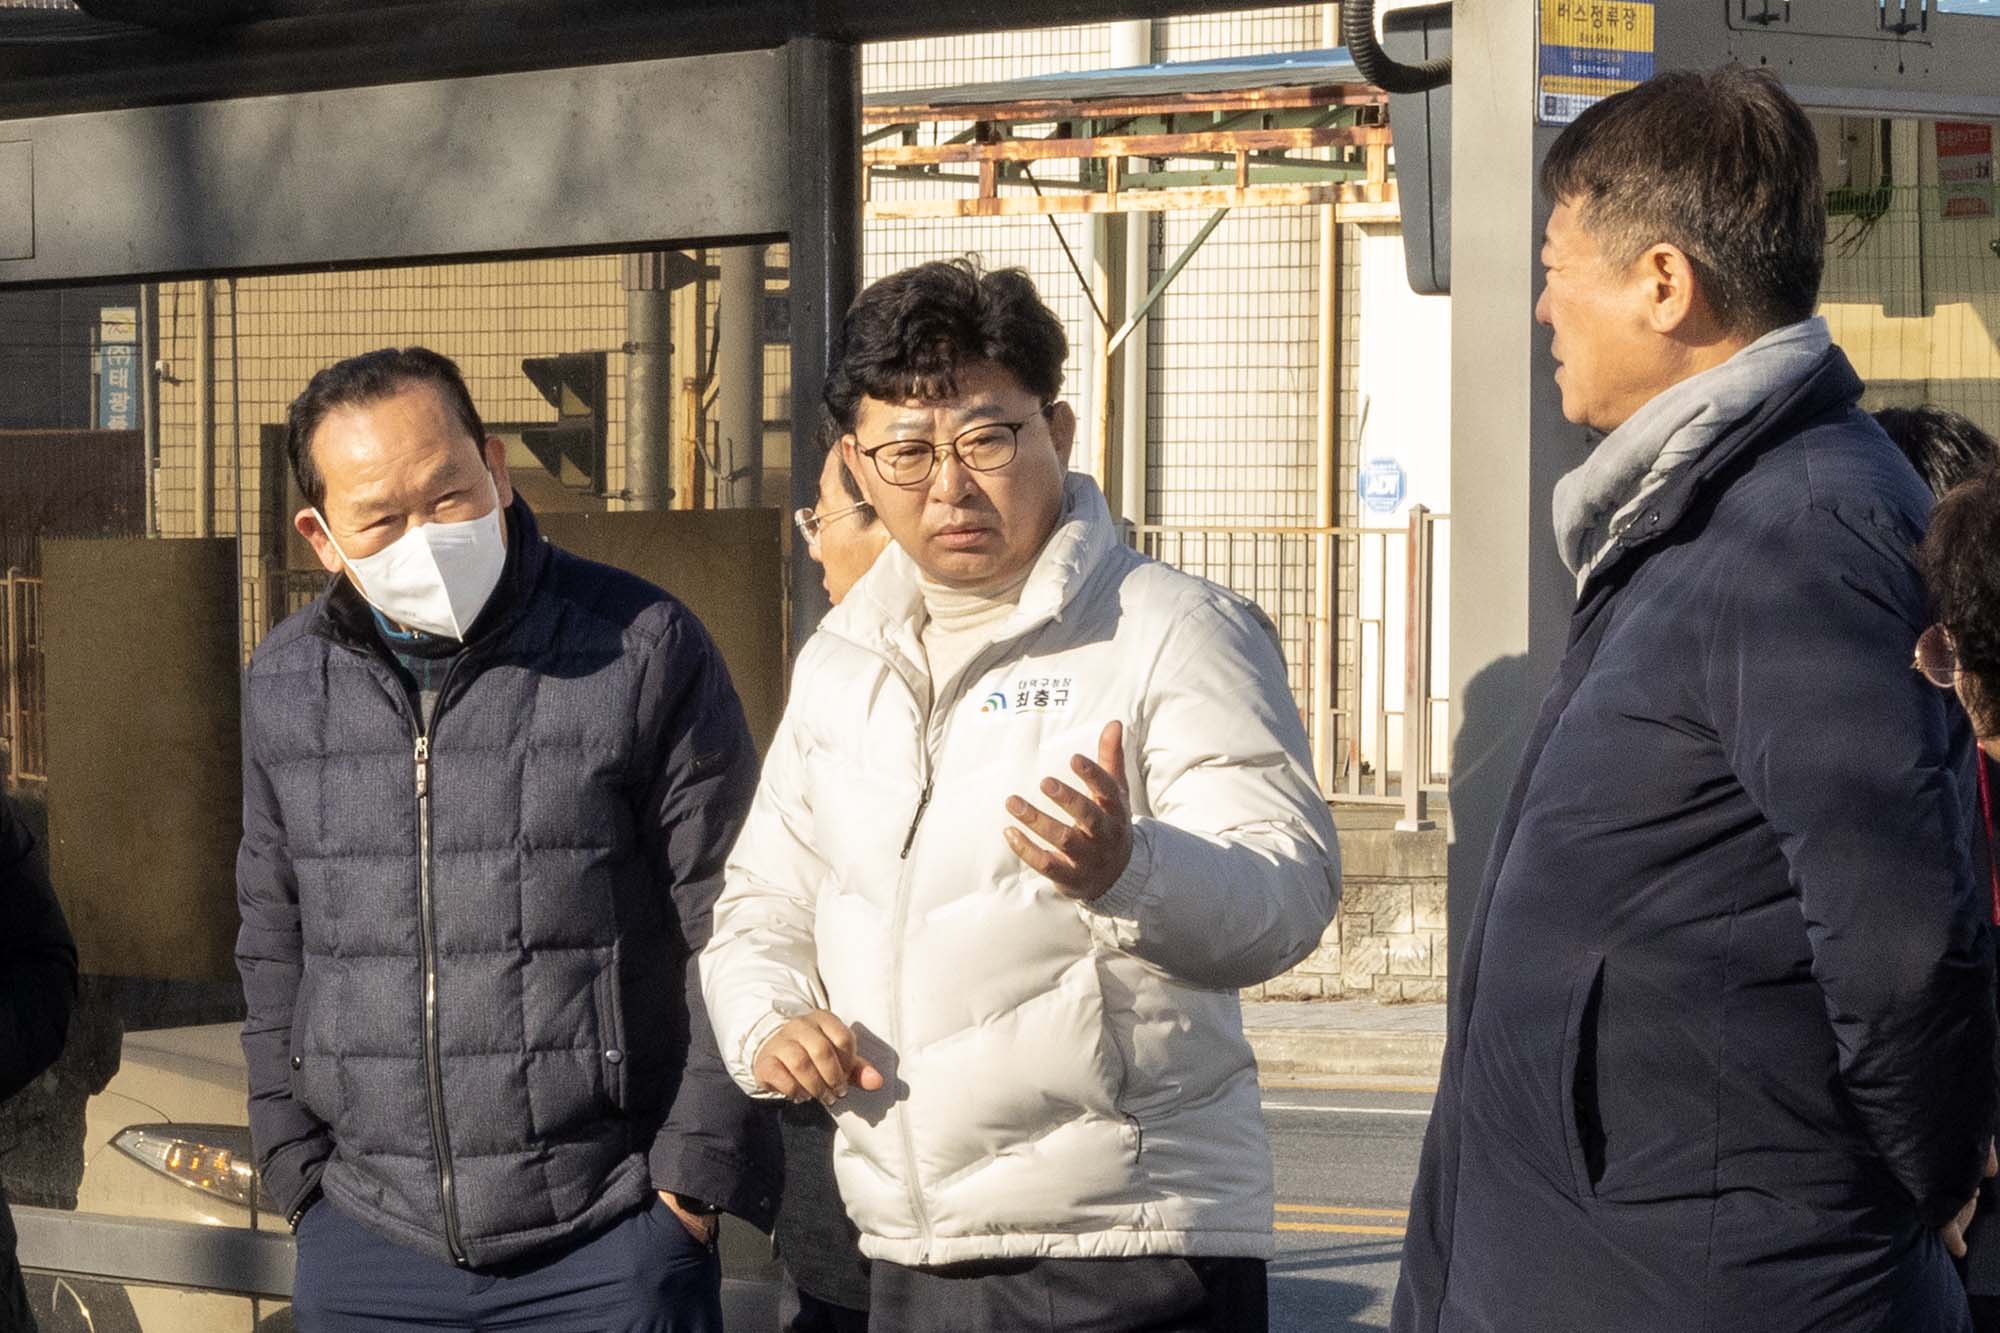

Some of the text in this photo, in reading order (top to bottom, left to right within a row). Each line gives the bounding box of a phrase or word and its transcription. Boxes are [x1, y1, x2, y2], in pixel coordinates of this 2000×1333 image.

[1558, 3, 1637, 31] 버스정류장
[1018, 678, 1072, 689] 대덕구청장
[1016, 689, 1069, 707] 최충규
